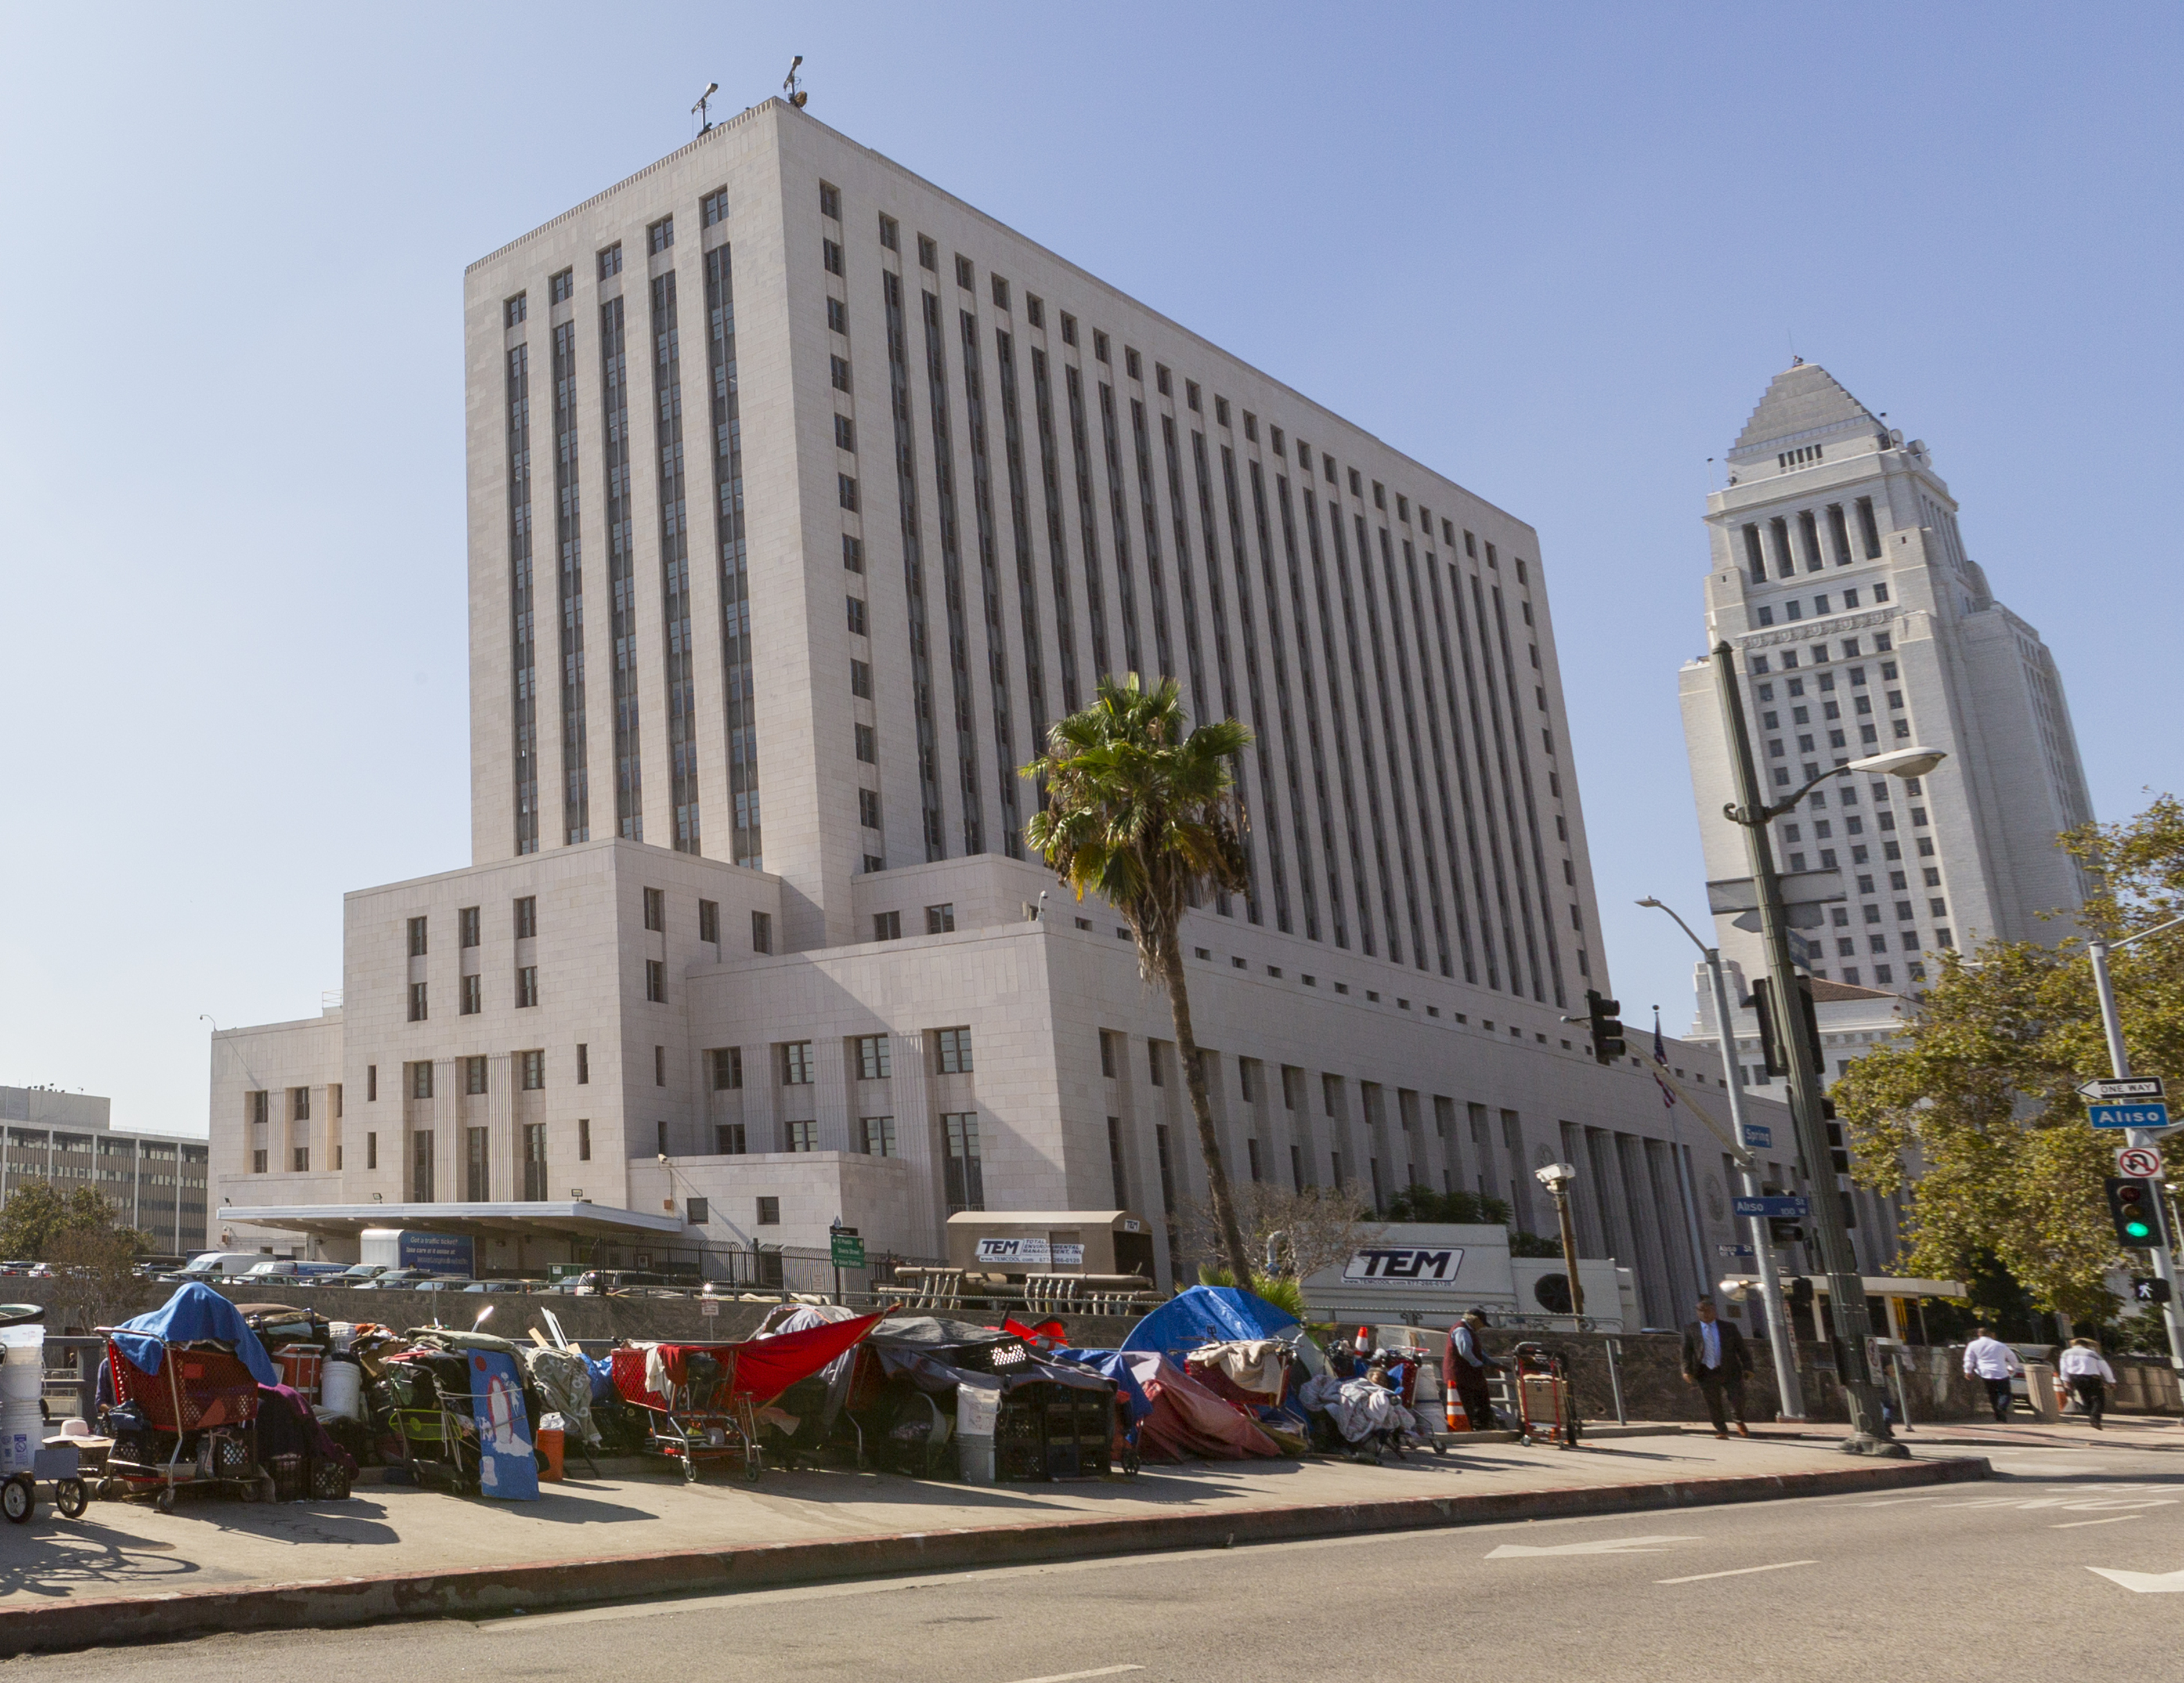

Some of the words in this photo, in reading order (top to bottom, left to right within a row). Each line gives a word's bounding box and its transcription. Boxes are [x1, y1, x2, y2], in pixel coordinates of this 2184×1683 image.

[2100, 1085, 2125, 1093] ONE
[2127, 1084, 2152, 1092] WAY
[2099, 1111, 2160, 1124] Aliso
[1746, 1128, 1770, 1146] Spring
[1737, 1201, 1764, 1212] Aliso
[1127, 1220, 1138, 1229] TEM
[981, 1241, 1020, 1254] TEM
[1359, 1250, 1452, 1278] TEM
